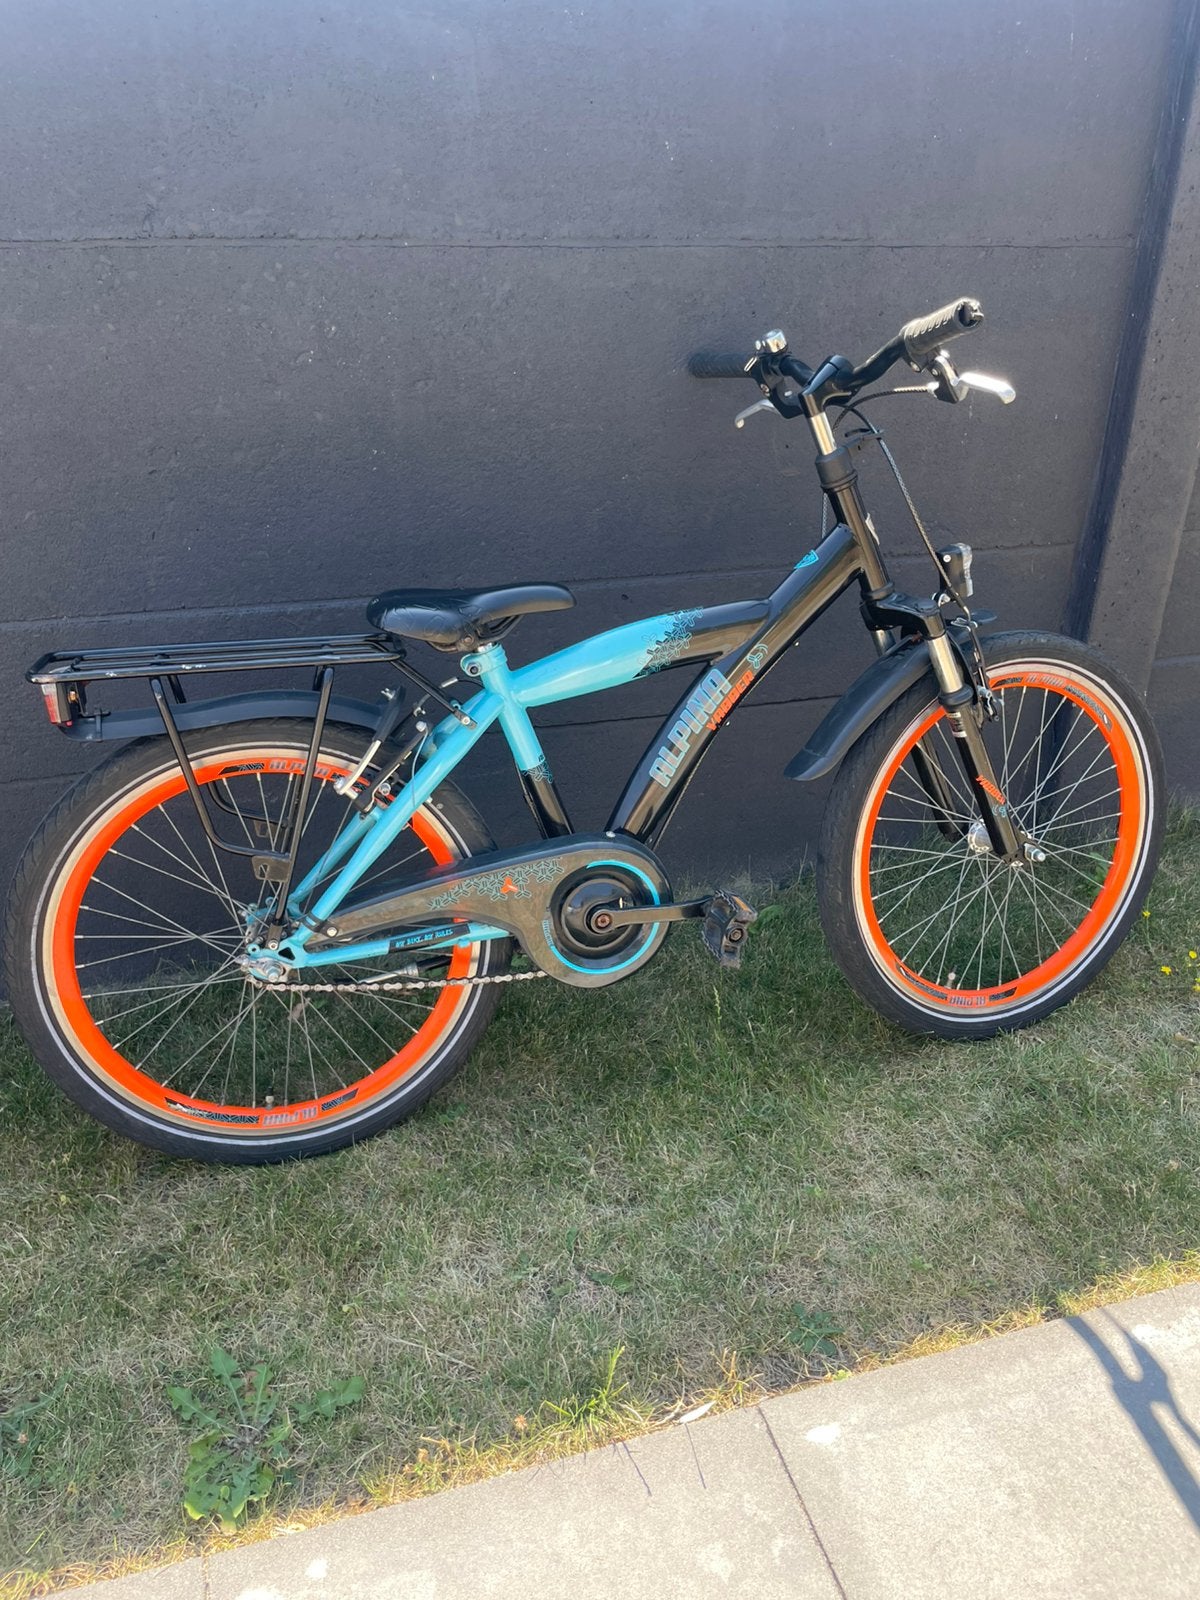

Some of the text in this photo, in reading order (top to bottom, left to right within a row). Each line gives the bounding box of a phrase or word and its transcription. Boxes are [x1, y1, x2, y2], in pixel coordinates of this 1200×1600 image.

[1026, 673, 1065, 687] ALPINA
[706, 670, 755, 731] YABBER
[649, 669, 732, 787] ALPINA
[949, 996, 986, 1006] ALPINA
[263, 1106, 318, 1126] ALPINA
